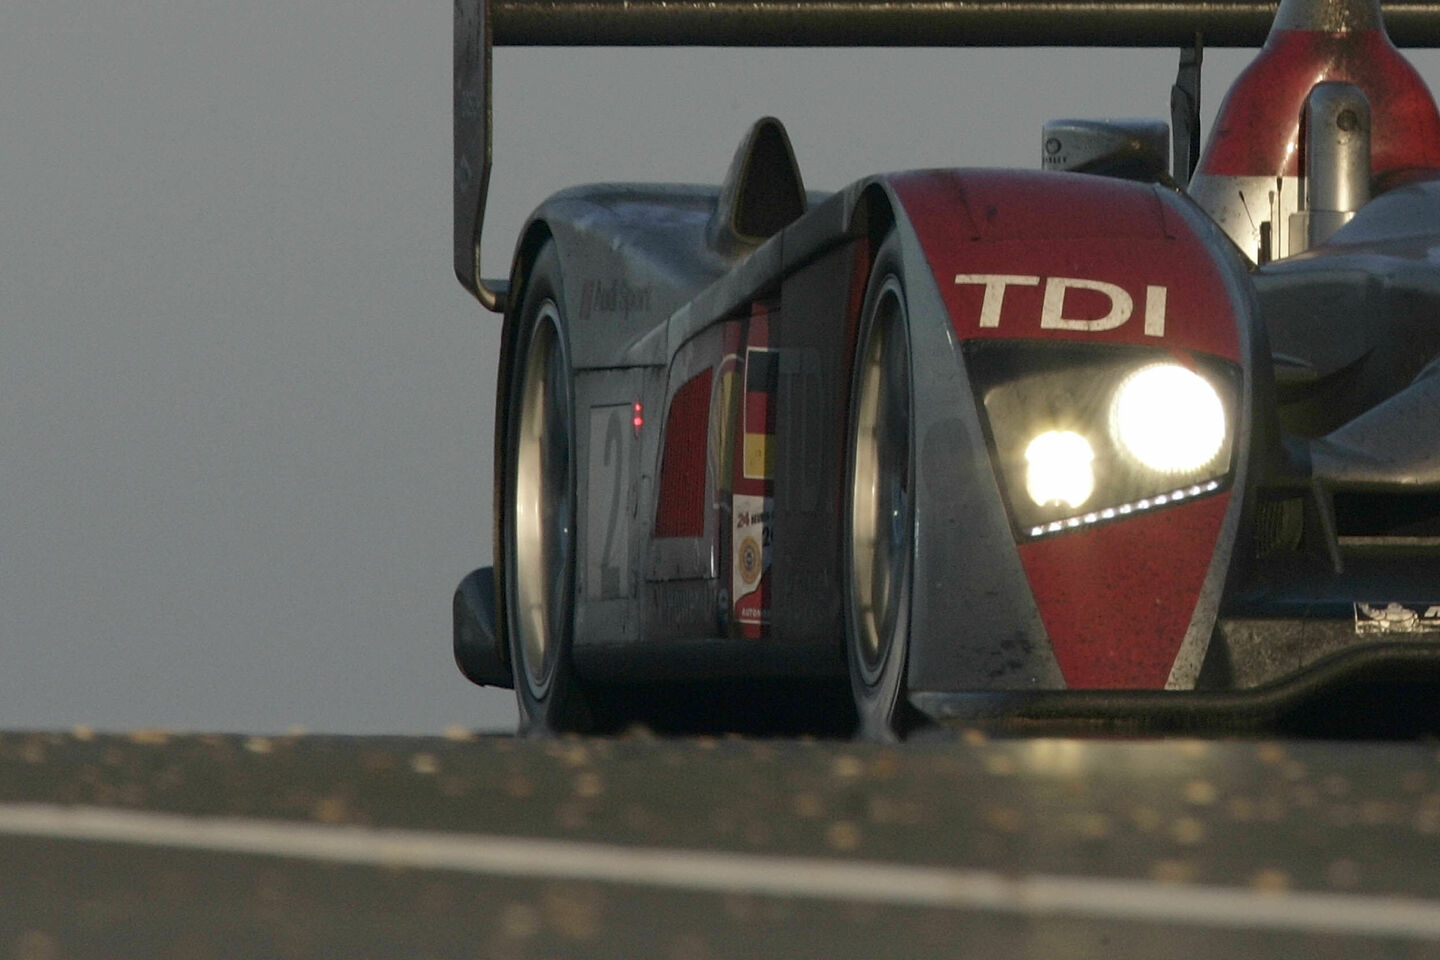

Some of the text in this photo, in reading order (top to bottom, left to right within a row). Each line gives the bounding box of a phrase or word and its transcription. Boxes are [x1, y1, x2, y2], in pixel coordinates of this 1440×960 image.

[955, 274, 1167, 337] TDI
[601, 410, 623, 600] 2
[737, 511, 750, 528] 24
